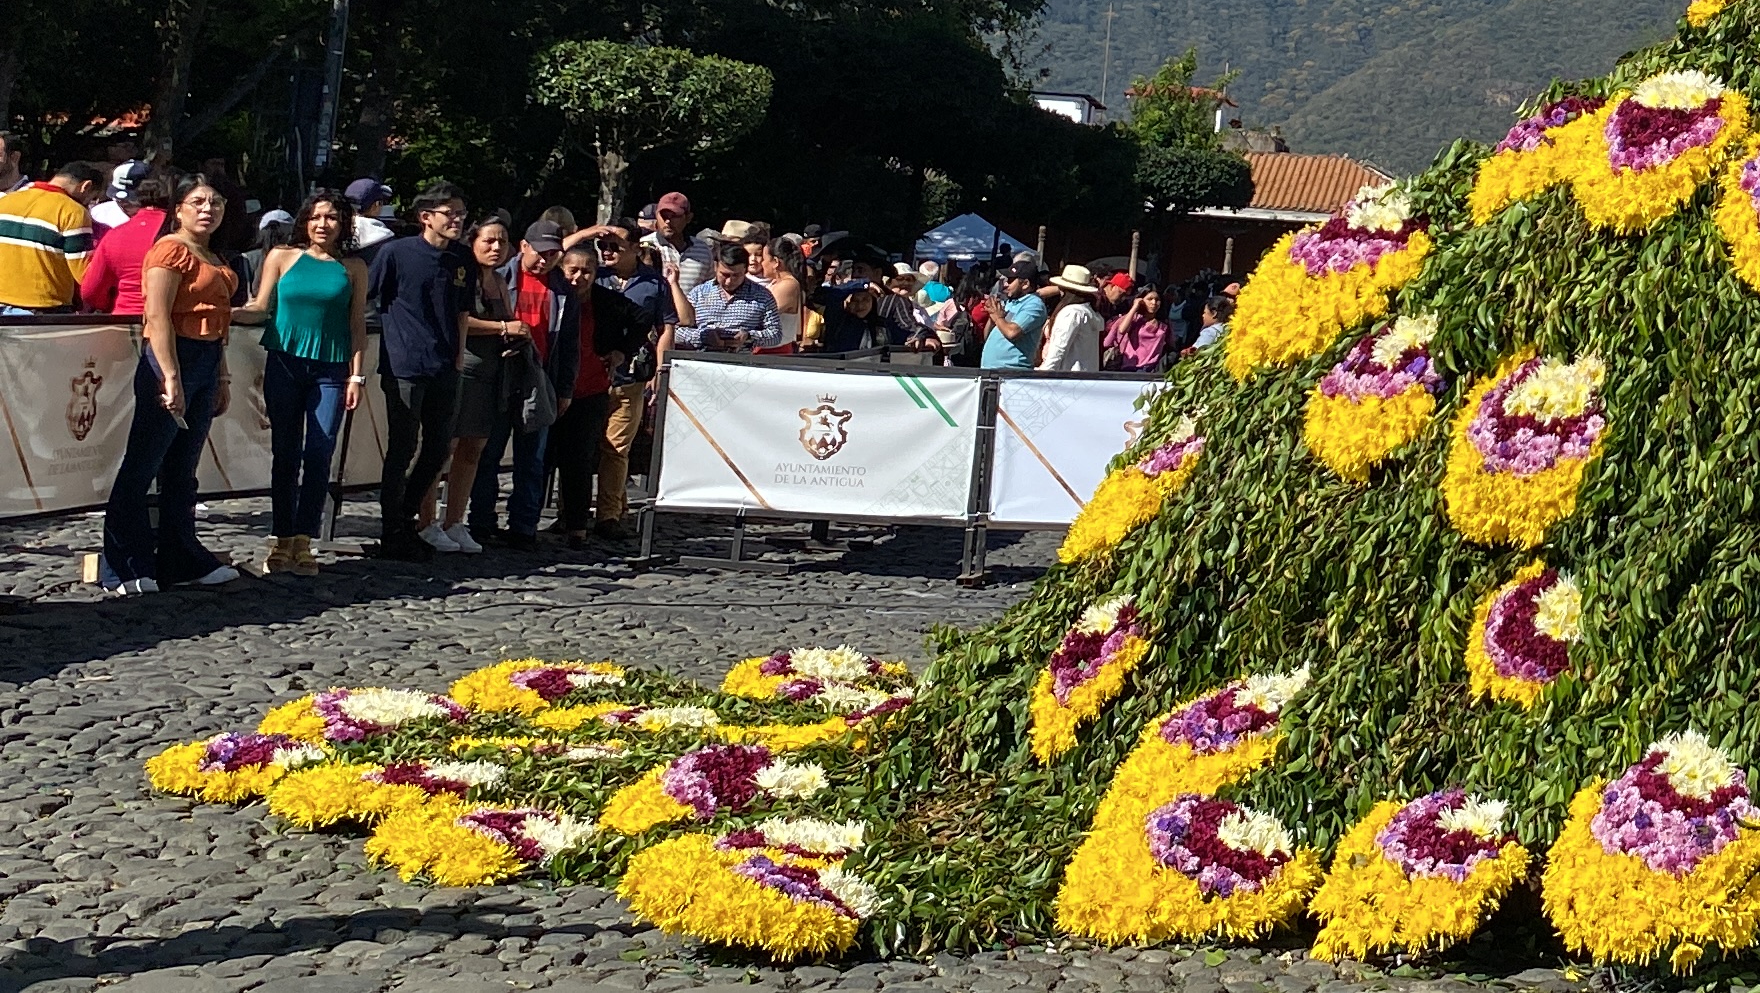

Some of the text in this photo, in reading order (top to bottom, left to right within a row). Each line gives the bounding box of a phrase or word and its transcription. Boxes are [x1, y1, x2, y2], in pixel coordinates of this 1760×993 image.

[775, 463, 867, 476] AYUNTAMIENTO
[774, 474, 865, 488] DE LA ANTIGUA
